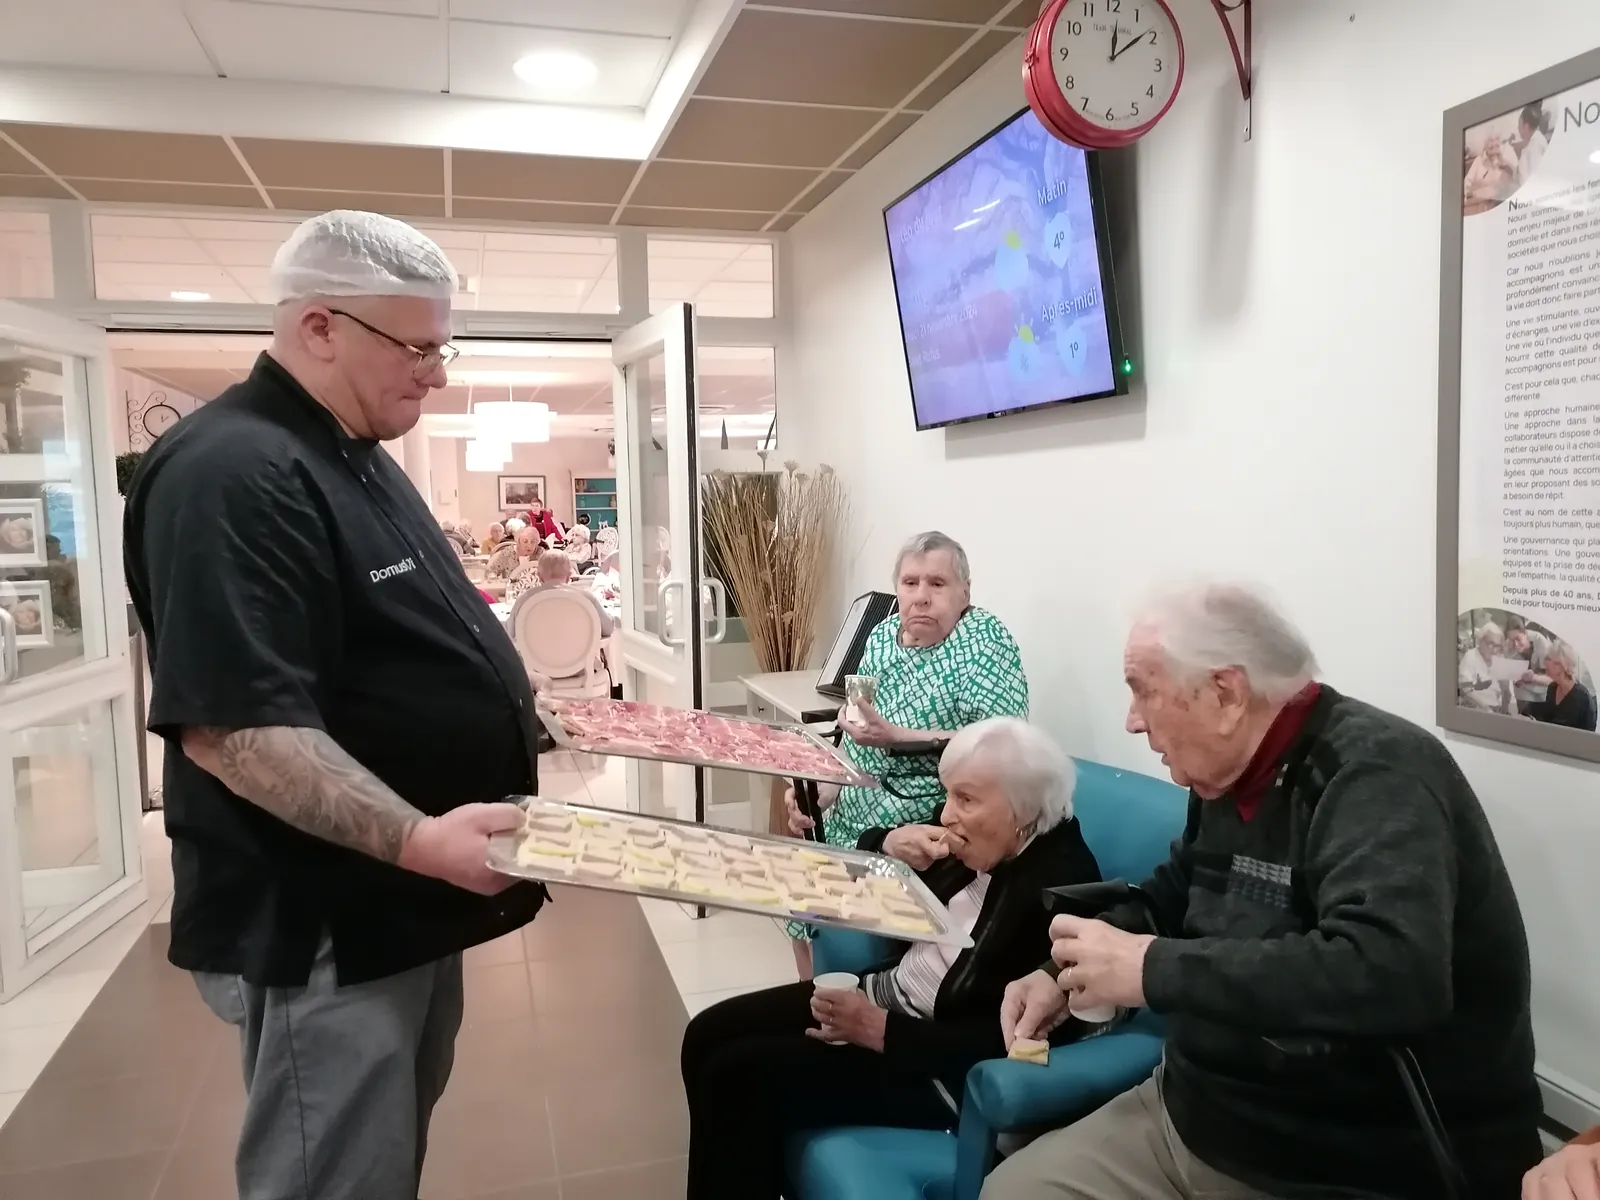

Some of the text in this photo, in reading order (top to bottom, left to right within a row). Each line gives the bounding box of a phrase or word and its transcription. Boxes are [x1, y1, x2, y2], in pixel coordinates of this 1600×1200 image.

[1083, 2, 1094, 17] 11
[1106, 0, 1120, 13] 12
[1066, 20, 1082, 36] 10
[1148, 30, 1157, 46] 2
[1060, 47, 1069, 61] 9
[1154, 58, 1162, 72] 3
[1065, 76, 1074, 90] 8
[1146, 84, 1154, 98] 4
[1080, 97, 1090, 111] 7
[1130, 102, 1139, 116] 5
[1105, 108, 1114, 122] 6
[1037, 178, 1068, 206] Matin
[1508, 214, 1527, 224] Nous
[1520, 222, 1541, 232] enjeu
[1543, 214, 1570, 226] majeur
[1573, 210, 1583, 218] de
[1508, 234, 1539, 248] domicile
[1541, 231, 1548, 239] et
[1551, 226, 1571, 236] dans
[1573, 222, 1588, 231] nos
[1508, 246, 1539, 259] sociétés
[1540, 243, 1555, 253] que
[1557, 236, 1577, 248] nous
[1507, 268, 1519, 276] Car
[1525, 262, 1543, 272] nous
[1507, 270, 1564, 288] accompagnons
[1569, 265, 1583, 274] est
[1506, 282, 1559, 301] profondément
[1514, 302, 1524, 310] vie
[1525, 299, 1540, 308] doit
[1542, 295, 1561, 304] donc
[1564, 291, 1582, 300] faire
[1506, 320, 1520, 328] Une
[1552, 324, 1567, 332] une
[1569, 320, 1581, 329] vie
[1535, 350, 1554, 358] cette
[1559, 344, 1587, 356] qualité
[1505, 361, 1561, 375] accompagnons
[1577, 356, 1597, 367] pour
[1505, 382, 1523, 391] C'est
[1525, 380, 1542, 390] pour
[1544, 377, 1559, 386] cela
[1505, 411, 1519, 419] Une
[1524, 408, 1560, 418] approche
[1525, 419, 1561, 429] approche
[1567, 417, 1586, 426] dans
[1505, 431, 1557, 442] collaborateurs
[1560, 428, 1590, 439] dispose
[1504, 445, 1527, 454] métier
[1529, 443, 1553, 454] qu'elle
[1512, 455, 1561, 465] communauté
[1504, 468, 1525, 479] âgées
[1530, 469, 1544, 477] que
[1549, 467, 1568, 476] nous
[1531, 479, 1570, 489] proposant
[1573, 479, 1588, 487] des
[1509, 492, 1533, 500] besoin
[1503, 508, 1521, 516] C'est
[1558, 508, 1567, 516] de
[1504, 520, 1534, 530] toujours
[1535, 521, 1551, 530] plus
[1521, 537, 1569, 545] gouvernance
[1572, 538, 1585, 547] qui
[1555, 549, 1570, 557] Une
[1503, 558, 1531, 568] équipes
[1553, 561, 1572, 570] prise
[1575, 562, 1585, 570] de
[1503, 571, 1516, 579] que
[1560, 573, 1566, 581] la
[1568, 575, 1595, 583] qualité
[1503, 586, 1528, 595] Depuis
[1531, 588, 1547, 597] plus
[1563, 590, 1573, 598] 40
[1523, 600, 1540, 608] pour
[1542, 601, 1575, 611] toujours
